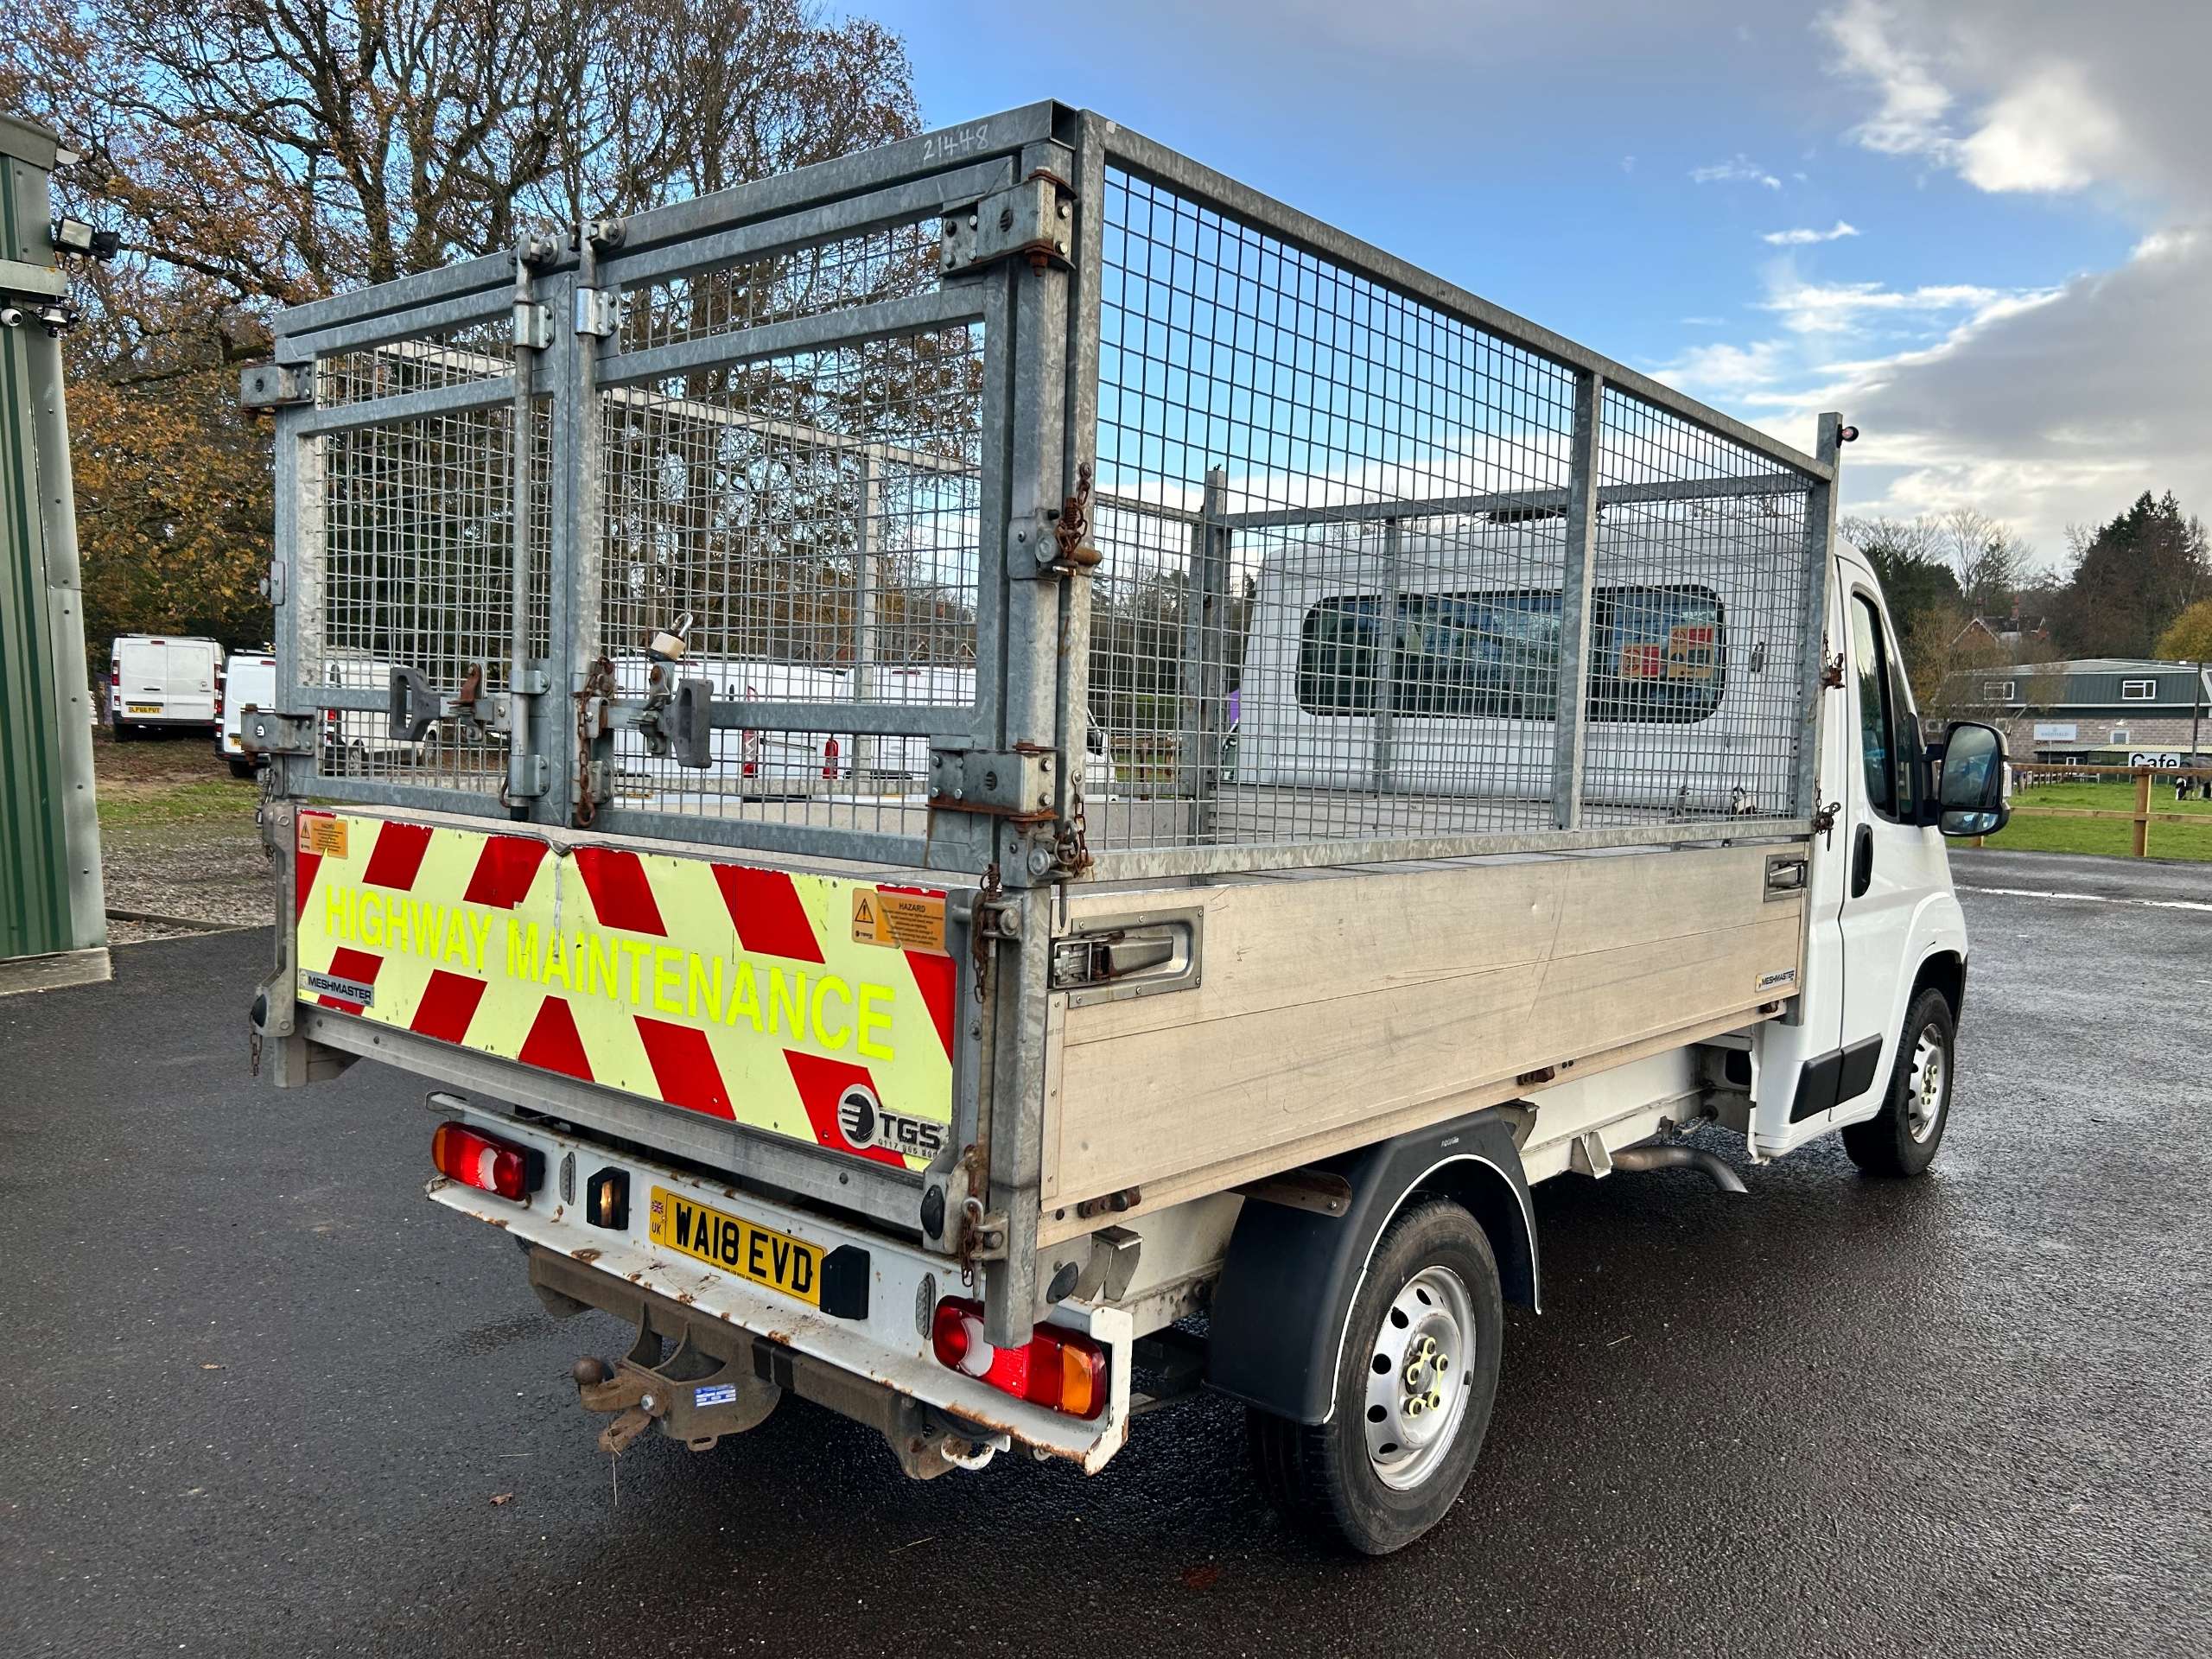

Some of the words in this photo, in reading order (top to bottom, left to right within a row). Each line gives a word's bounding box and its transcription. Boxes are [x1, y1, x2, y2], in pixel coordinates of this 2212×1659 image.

[2131, 753, 2177, 767] Cafe
[325, 884, 493, 970] HIGHWAY
[506, 918, 895, 1062] MAINTENANCE
[1761, 969, 1795, 985] MESHMASTER
[308, 976, 372, 1001] MESHMASTER
[879, 1112, 942, 1150] TGS
[652, 1222, 661, 1236] UK
[676, 1202, 741, 1266] WA18
[748, 1230, 813, 1294] EVD
